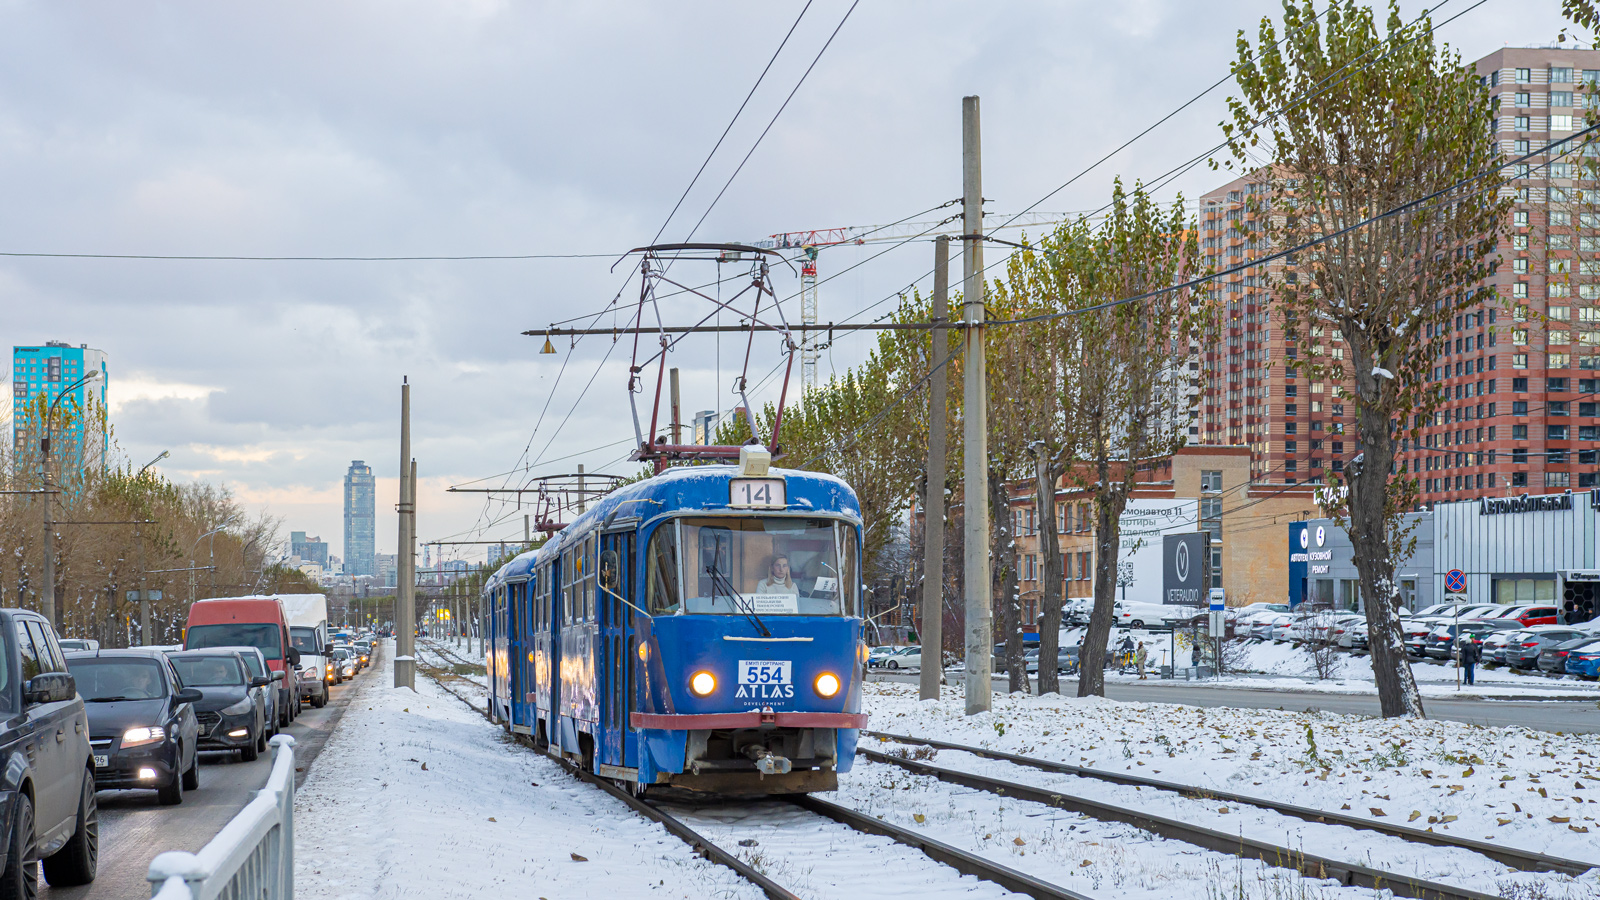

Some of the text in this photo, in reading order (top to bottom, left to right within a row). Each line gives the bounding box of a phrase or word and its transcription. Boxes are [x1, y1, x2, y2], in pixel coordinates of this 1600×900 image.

[742, 484, 772, 508] 14
[1480, 489, 1573, 515] Автомобильный
[1121, 507, 1182, 516] смонавтов 11
[1119, 519, 1156, 527] артиры
[1122, 538, 1148, 548] piku
[1309, 549, 1332, 560] КУЗОВНОЙ
[1312, 565, 1329, 574] РЕМОНТ
[1167, 589, 1198, 602] VETERAUDIO
[747, 667, 783, 683] 554
[735, 684, 794, 698] ATLAS
